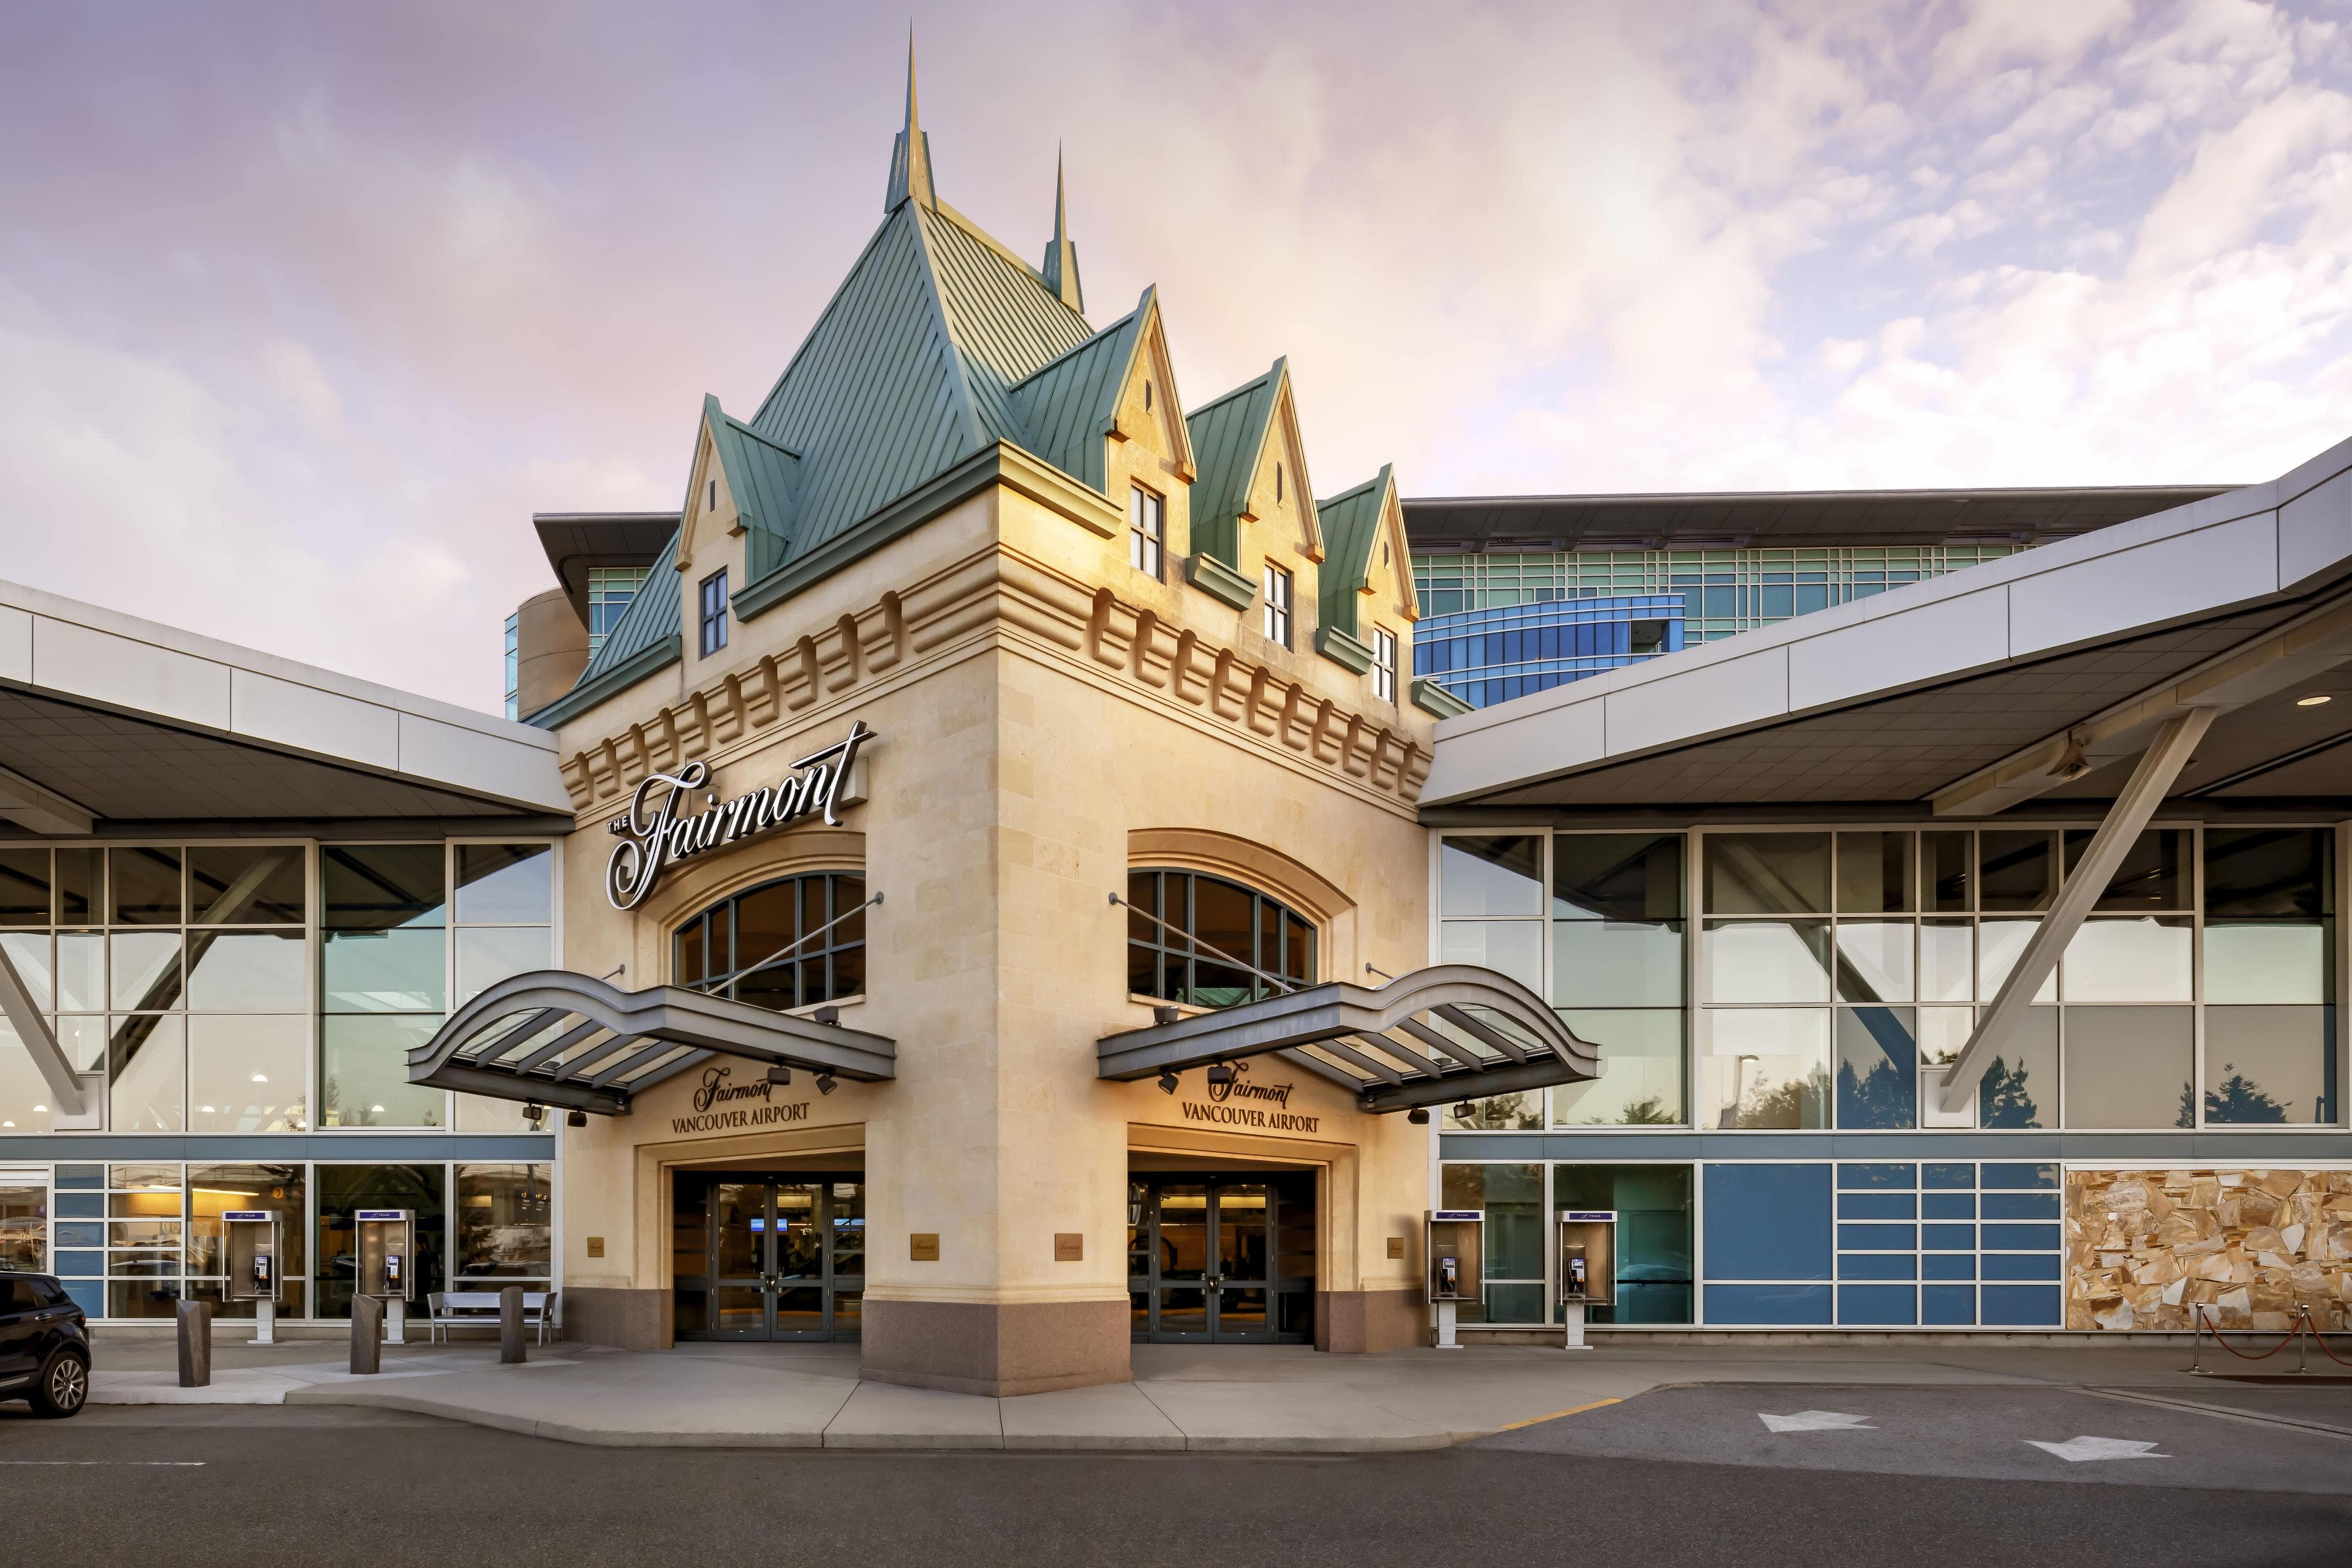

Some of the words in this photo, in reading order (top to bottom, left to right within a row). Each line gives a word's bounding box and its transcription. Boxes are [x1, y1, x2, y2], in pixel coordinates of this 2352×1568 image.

[605, 720, 878, 911] Fairmont
[606, 815, 628, 834] THE
[693, 1067, 774, 1113] Fairmont
[1208, 1060, 1295, 1109] Fairmont
[672, 1110, 748, 1134] VANCOUVER
[750, 1102, 810, 1125] AIRPORT
[1182, 1102, 1267, 1128] VANCOUVER
[1268, 1112, 1320, 1133] AIRPORT
